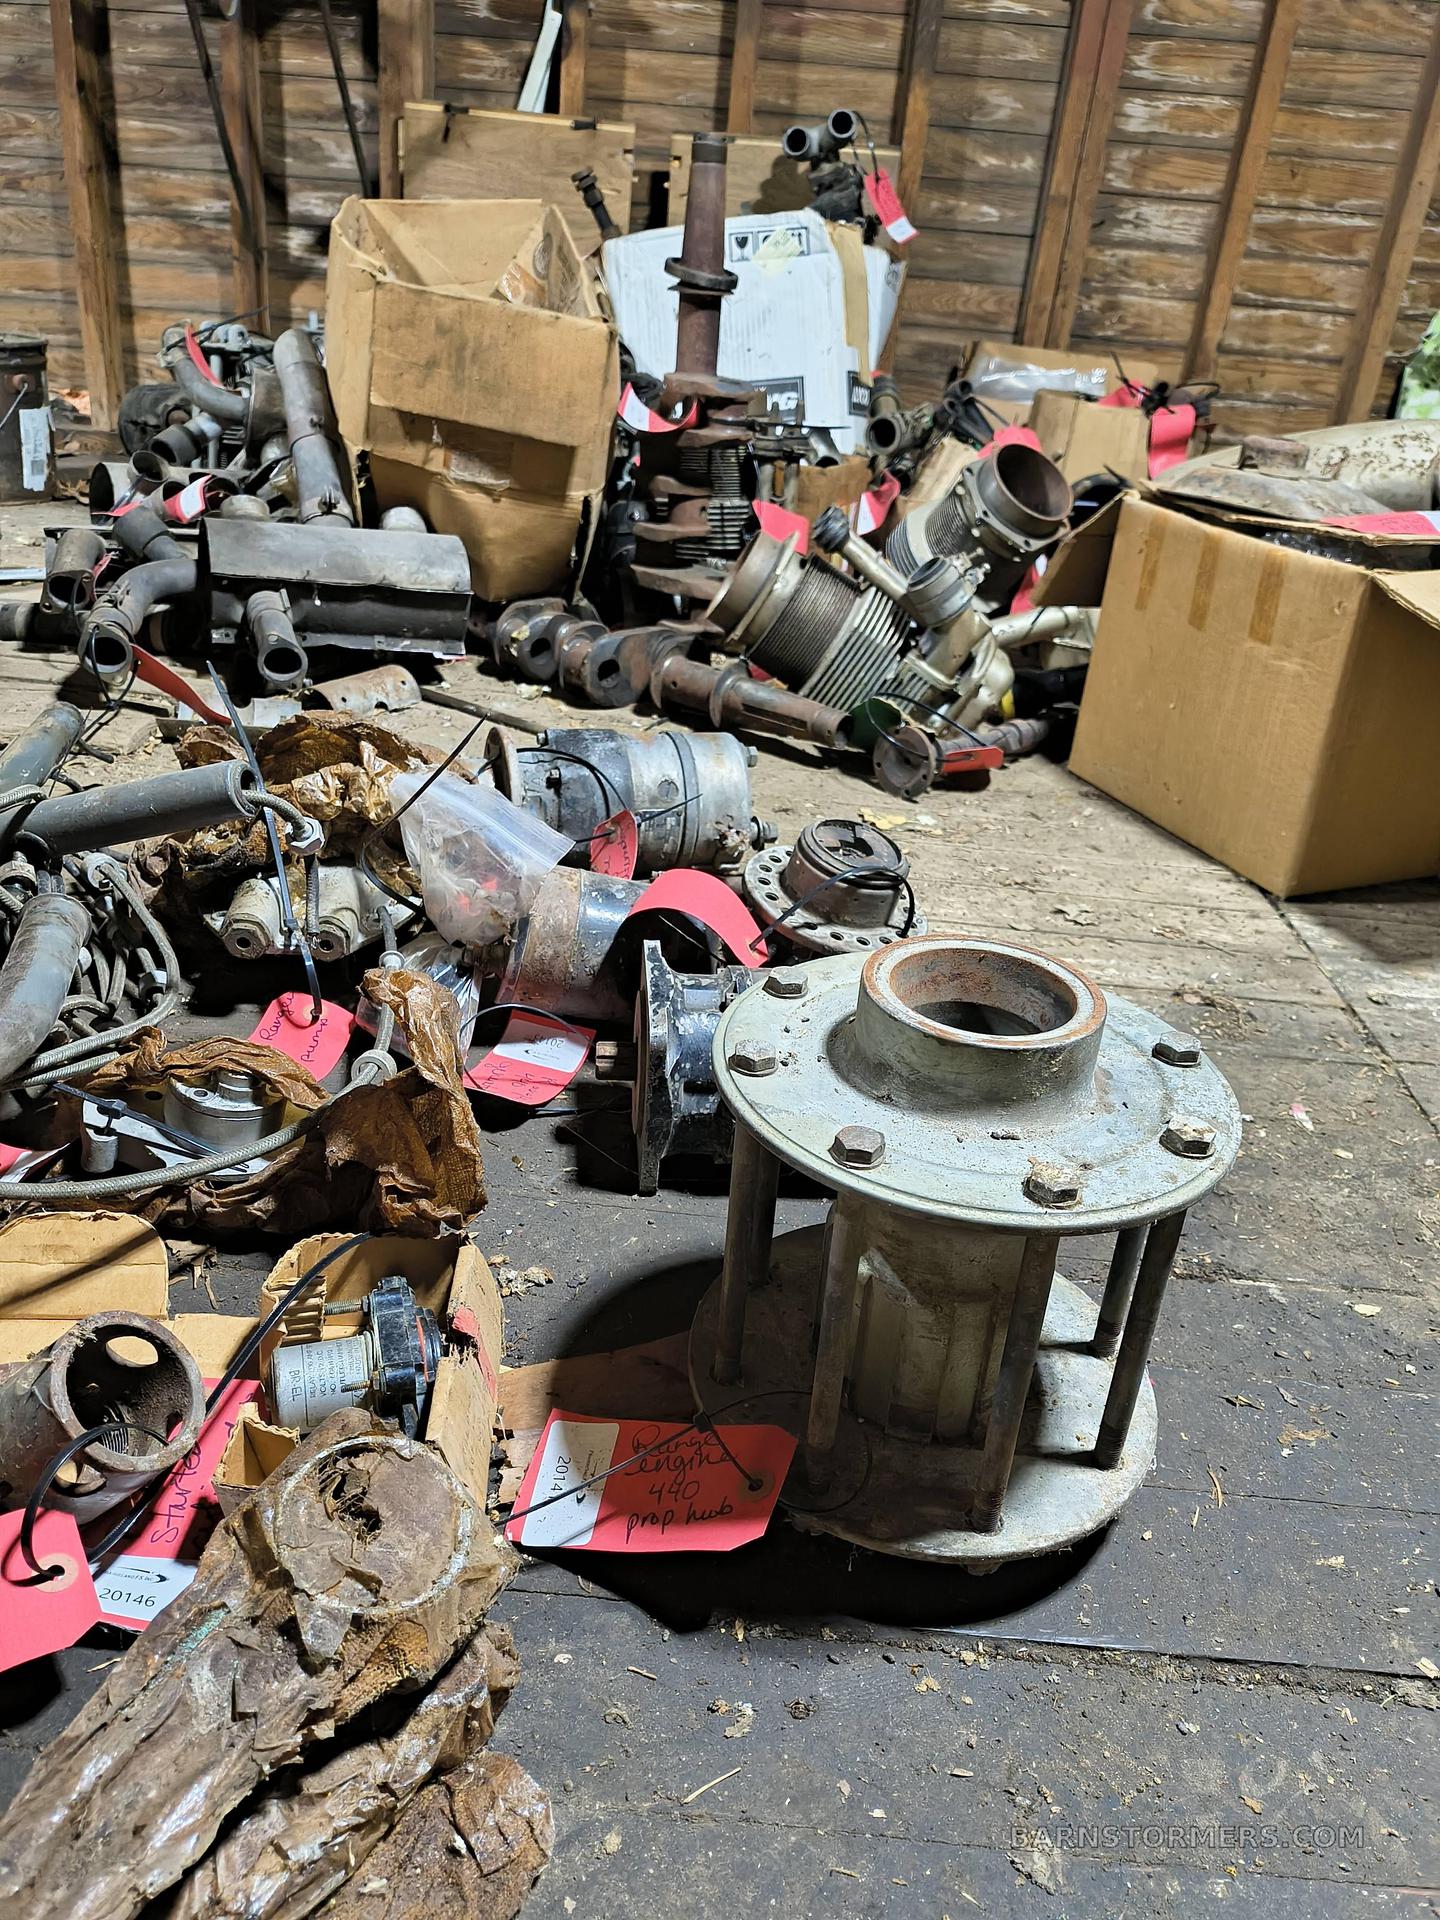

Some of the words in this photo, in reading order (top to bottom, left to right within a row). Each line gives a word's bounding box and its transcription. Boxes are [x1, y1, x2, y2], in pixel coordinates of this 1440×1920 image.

[548, 1455, 572, 1502] 2014
[624, 1450, 737, 1483] engine
[649, 1481, 700, 1505] 440
[626, 1509, 674, 1545] prop
[686, 1497, 734, 1526] hub
[99, 1587, 156, 1608] 20146
